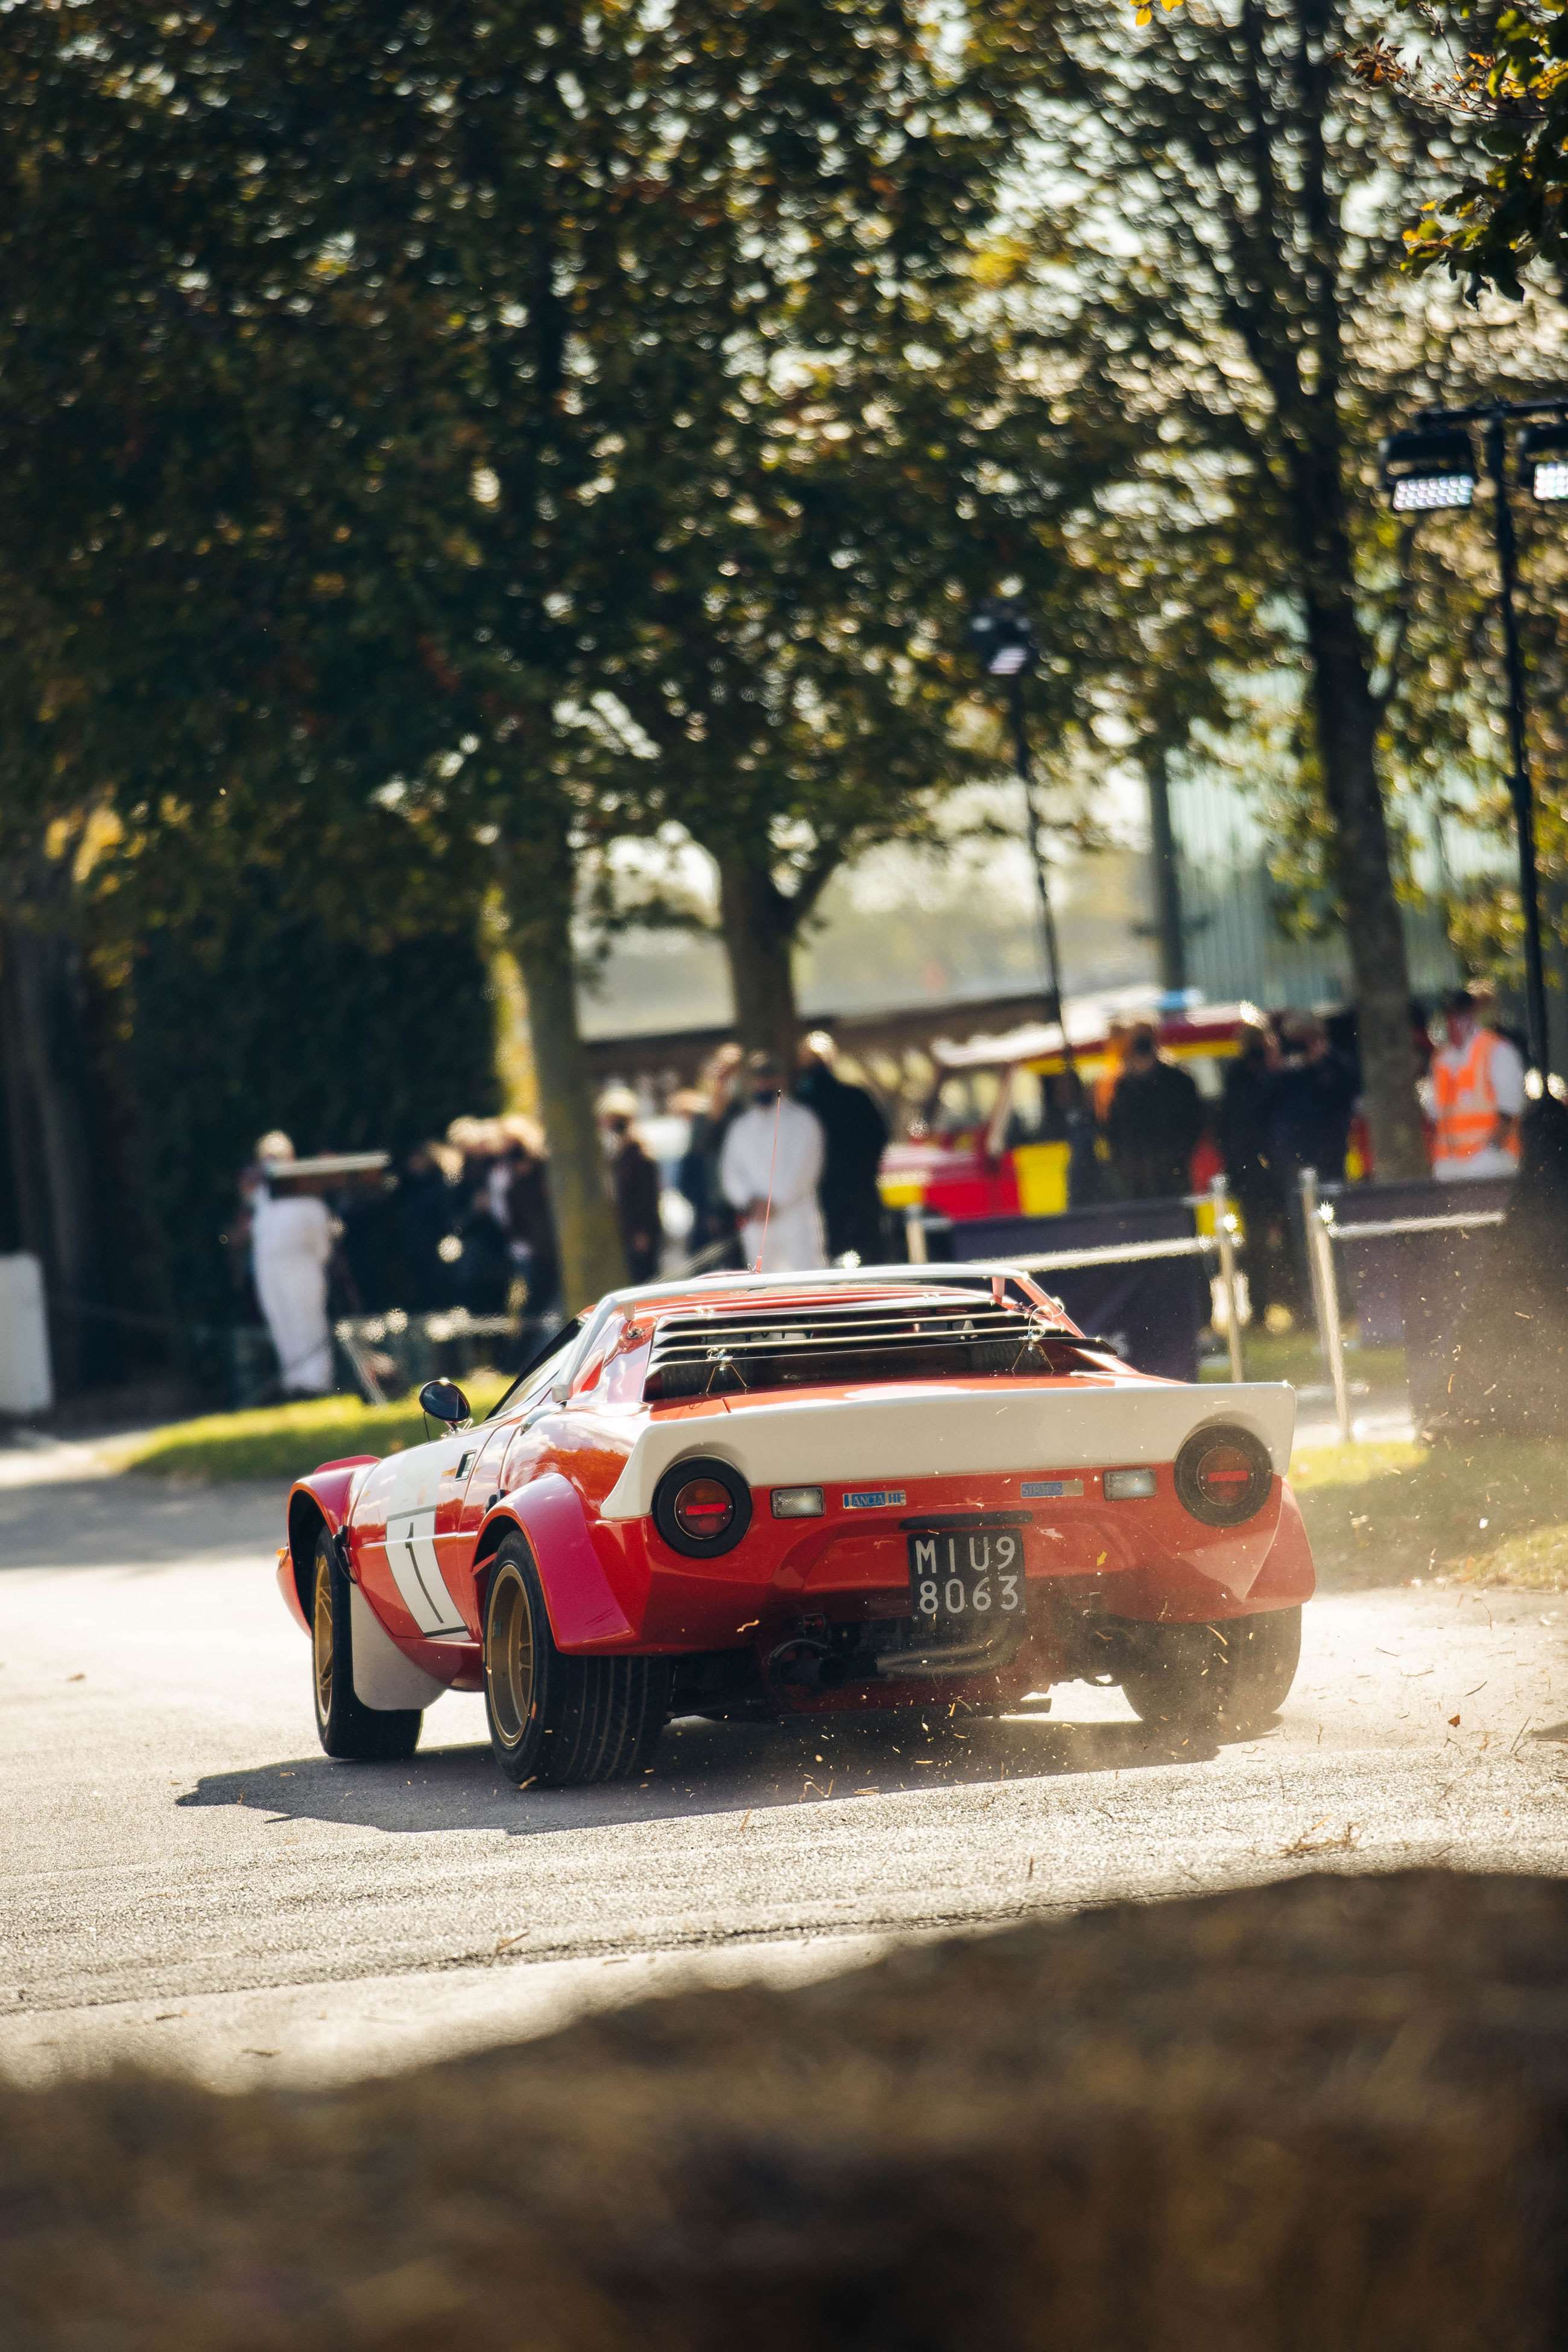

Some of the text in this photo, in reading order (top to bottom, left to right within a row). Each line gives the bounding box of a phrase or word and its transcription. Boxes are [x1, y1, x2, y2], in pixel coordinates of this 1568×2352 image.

[848, 1492, 885, 1508] LANCIA
[405, 1522, 444, 1623] 1
[919, 1575, 1019, 1614] 8063
